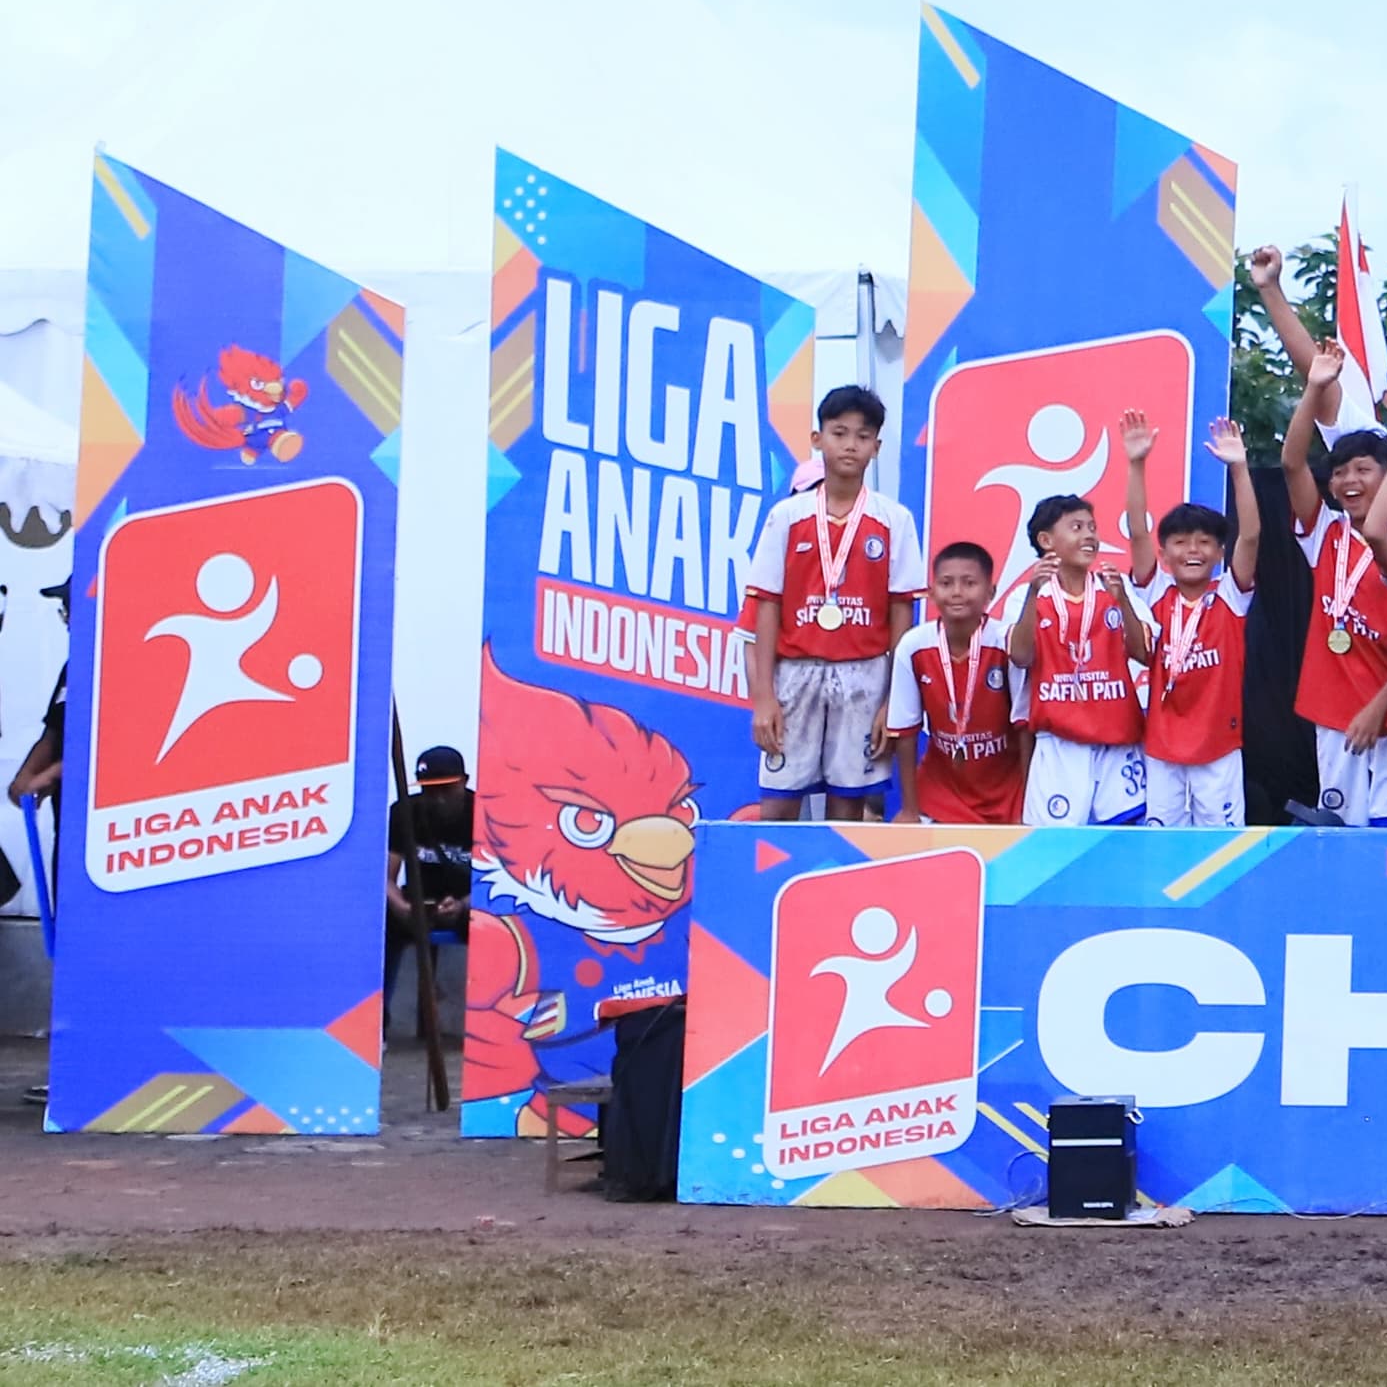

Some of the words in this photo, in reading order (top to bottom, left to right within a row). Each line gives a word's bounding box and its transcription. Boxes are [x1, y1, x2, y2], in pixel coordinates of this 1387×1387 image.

[543, 277, 762, 490] LIGA
[538, 448, 762, 615] ANAK
[542, 588, 749, 700] INDONESIA
[1092, 679, 1126, 700] PATI
[1121, 759, 1147, 796] 32
[108, 808, 201, 842] LIGA
[212, 783, 330, 824] ANAK
[106, 816, 328, 873] INDONESIA
[779, 1120, 957, 1165] INDONESIA
[780, 1112, 855, 1140] LIGA
[864, 1094, 957, 1126] ANAK
